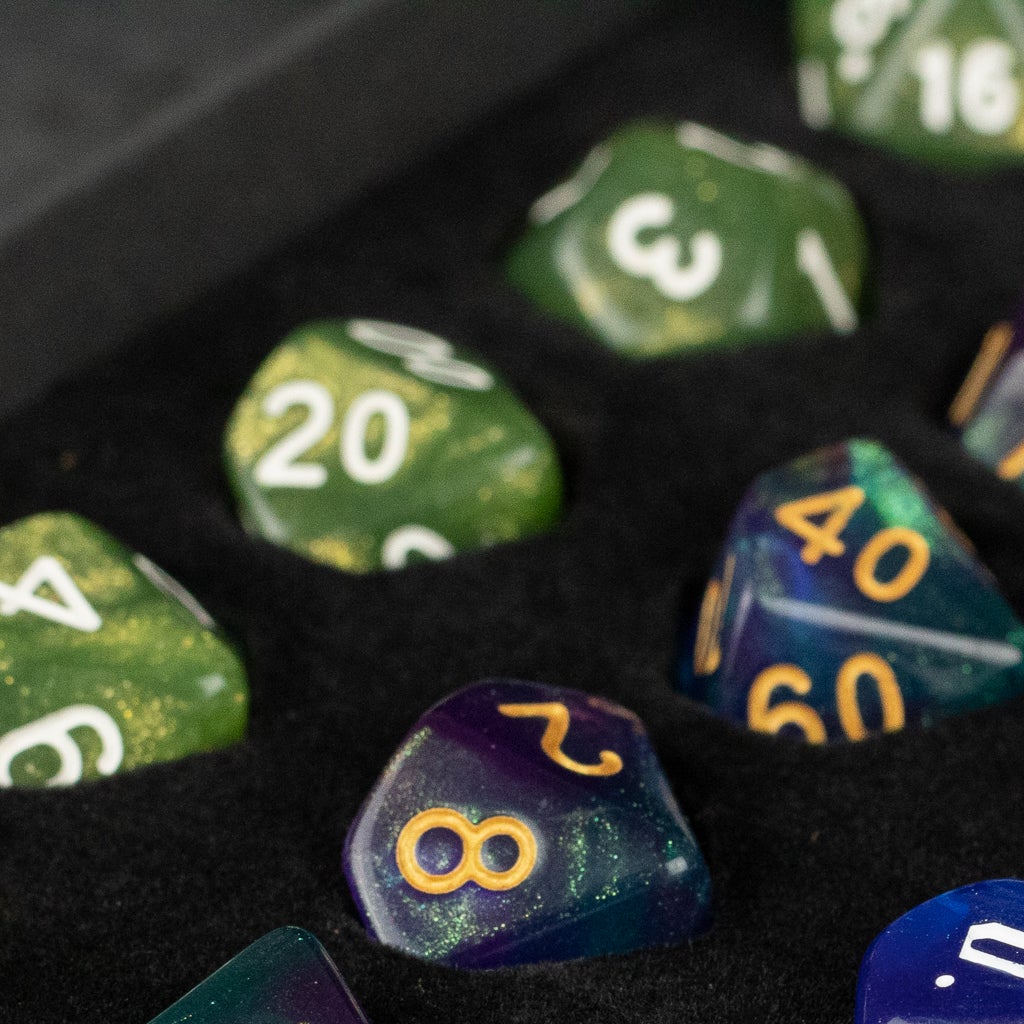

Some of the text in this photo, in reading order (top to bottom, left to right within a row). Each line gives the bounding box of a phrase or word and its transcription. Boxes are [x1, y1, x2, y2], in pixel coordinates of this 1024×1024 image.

[912, 38, 1019, 135] 16
[606, 191, 723, 301] 3
[253, 377, 410, 489] 20
[774, 486, 930, 603] 40
[498, 702, 624, 776] 2
[747, 652, 905, 745] 60
[396, 807, 538, 894] 8
